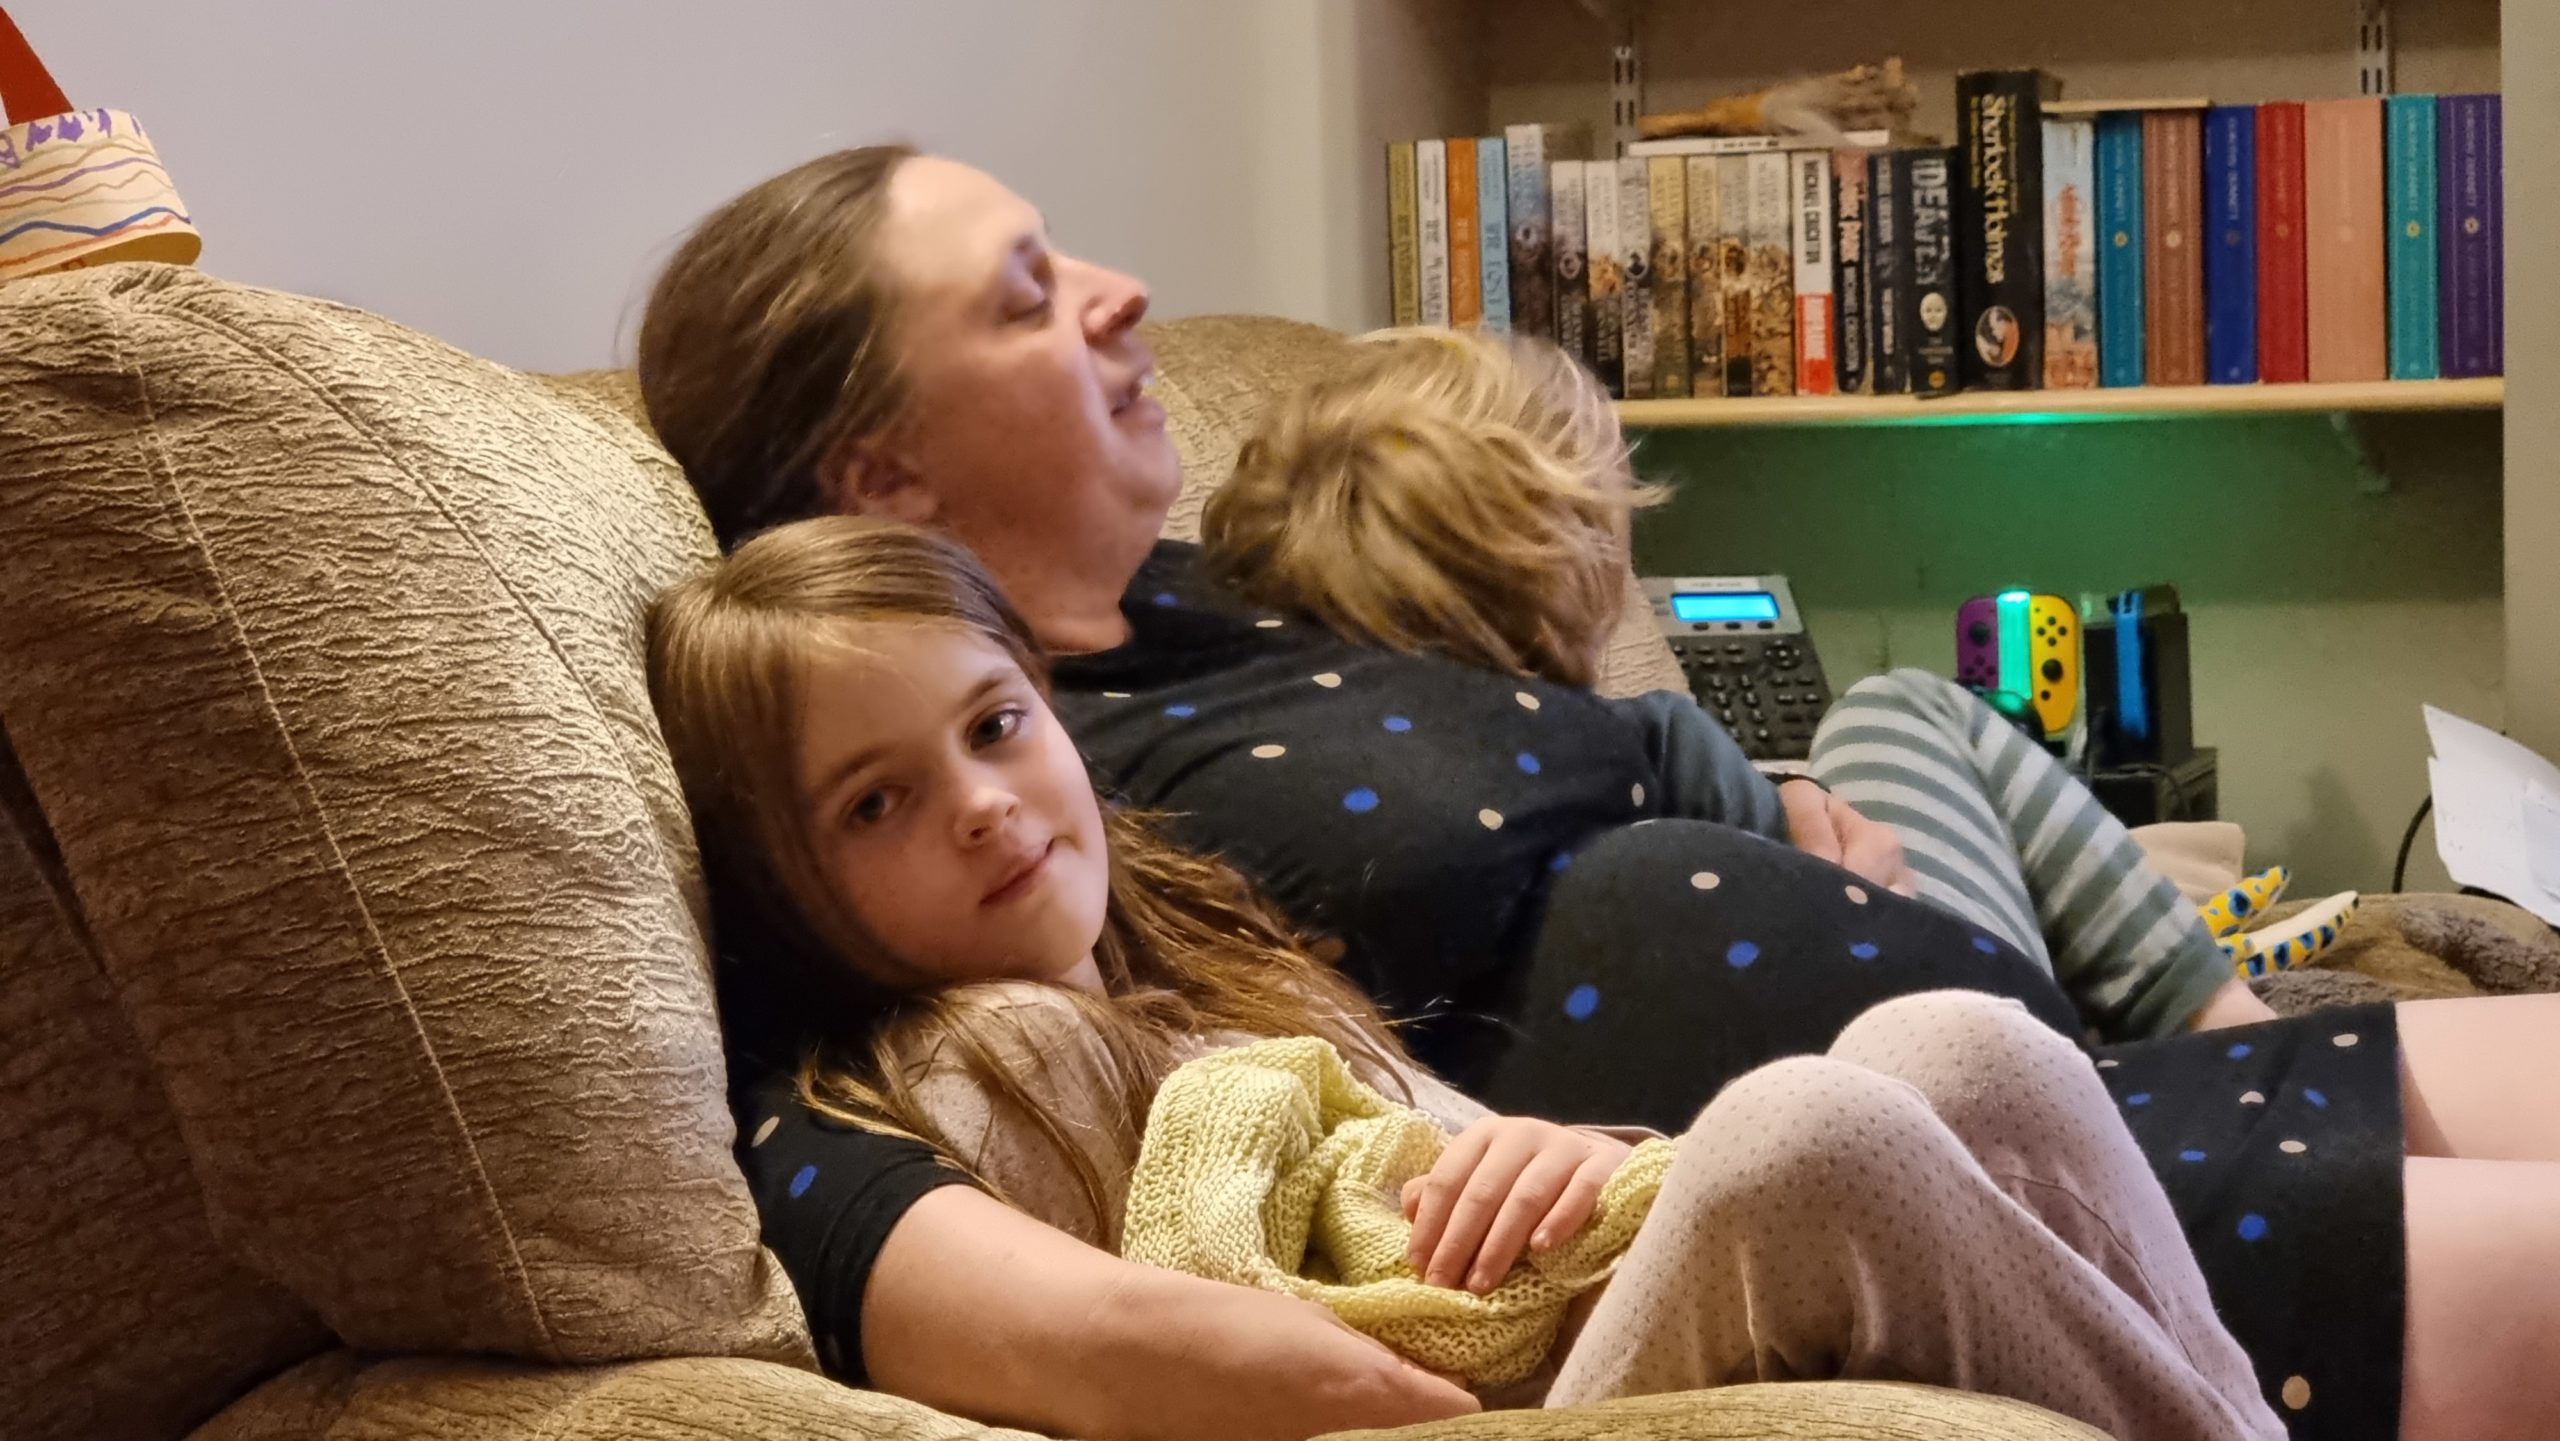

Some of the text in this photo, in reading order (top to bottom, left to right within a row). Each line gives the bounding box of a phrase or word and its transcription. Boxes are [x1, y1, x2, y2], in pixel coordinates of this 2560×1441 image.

[1982, 94, 2008, 196] Sherlock
[1804, 160, 1822, 265] MICHAEL CRICHTON
